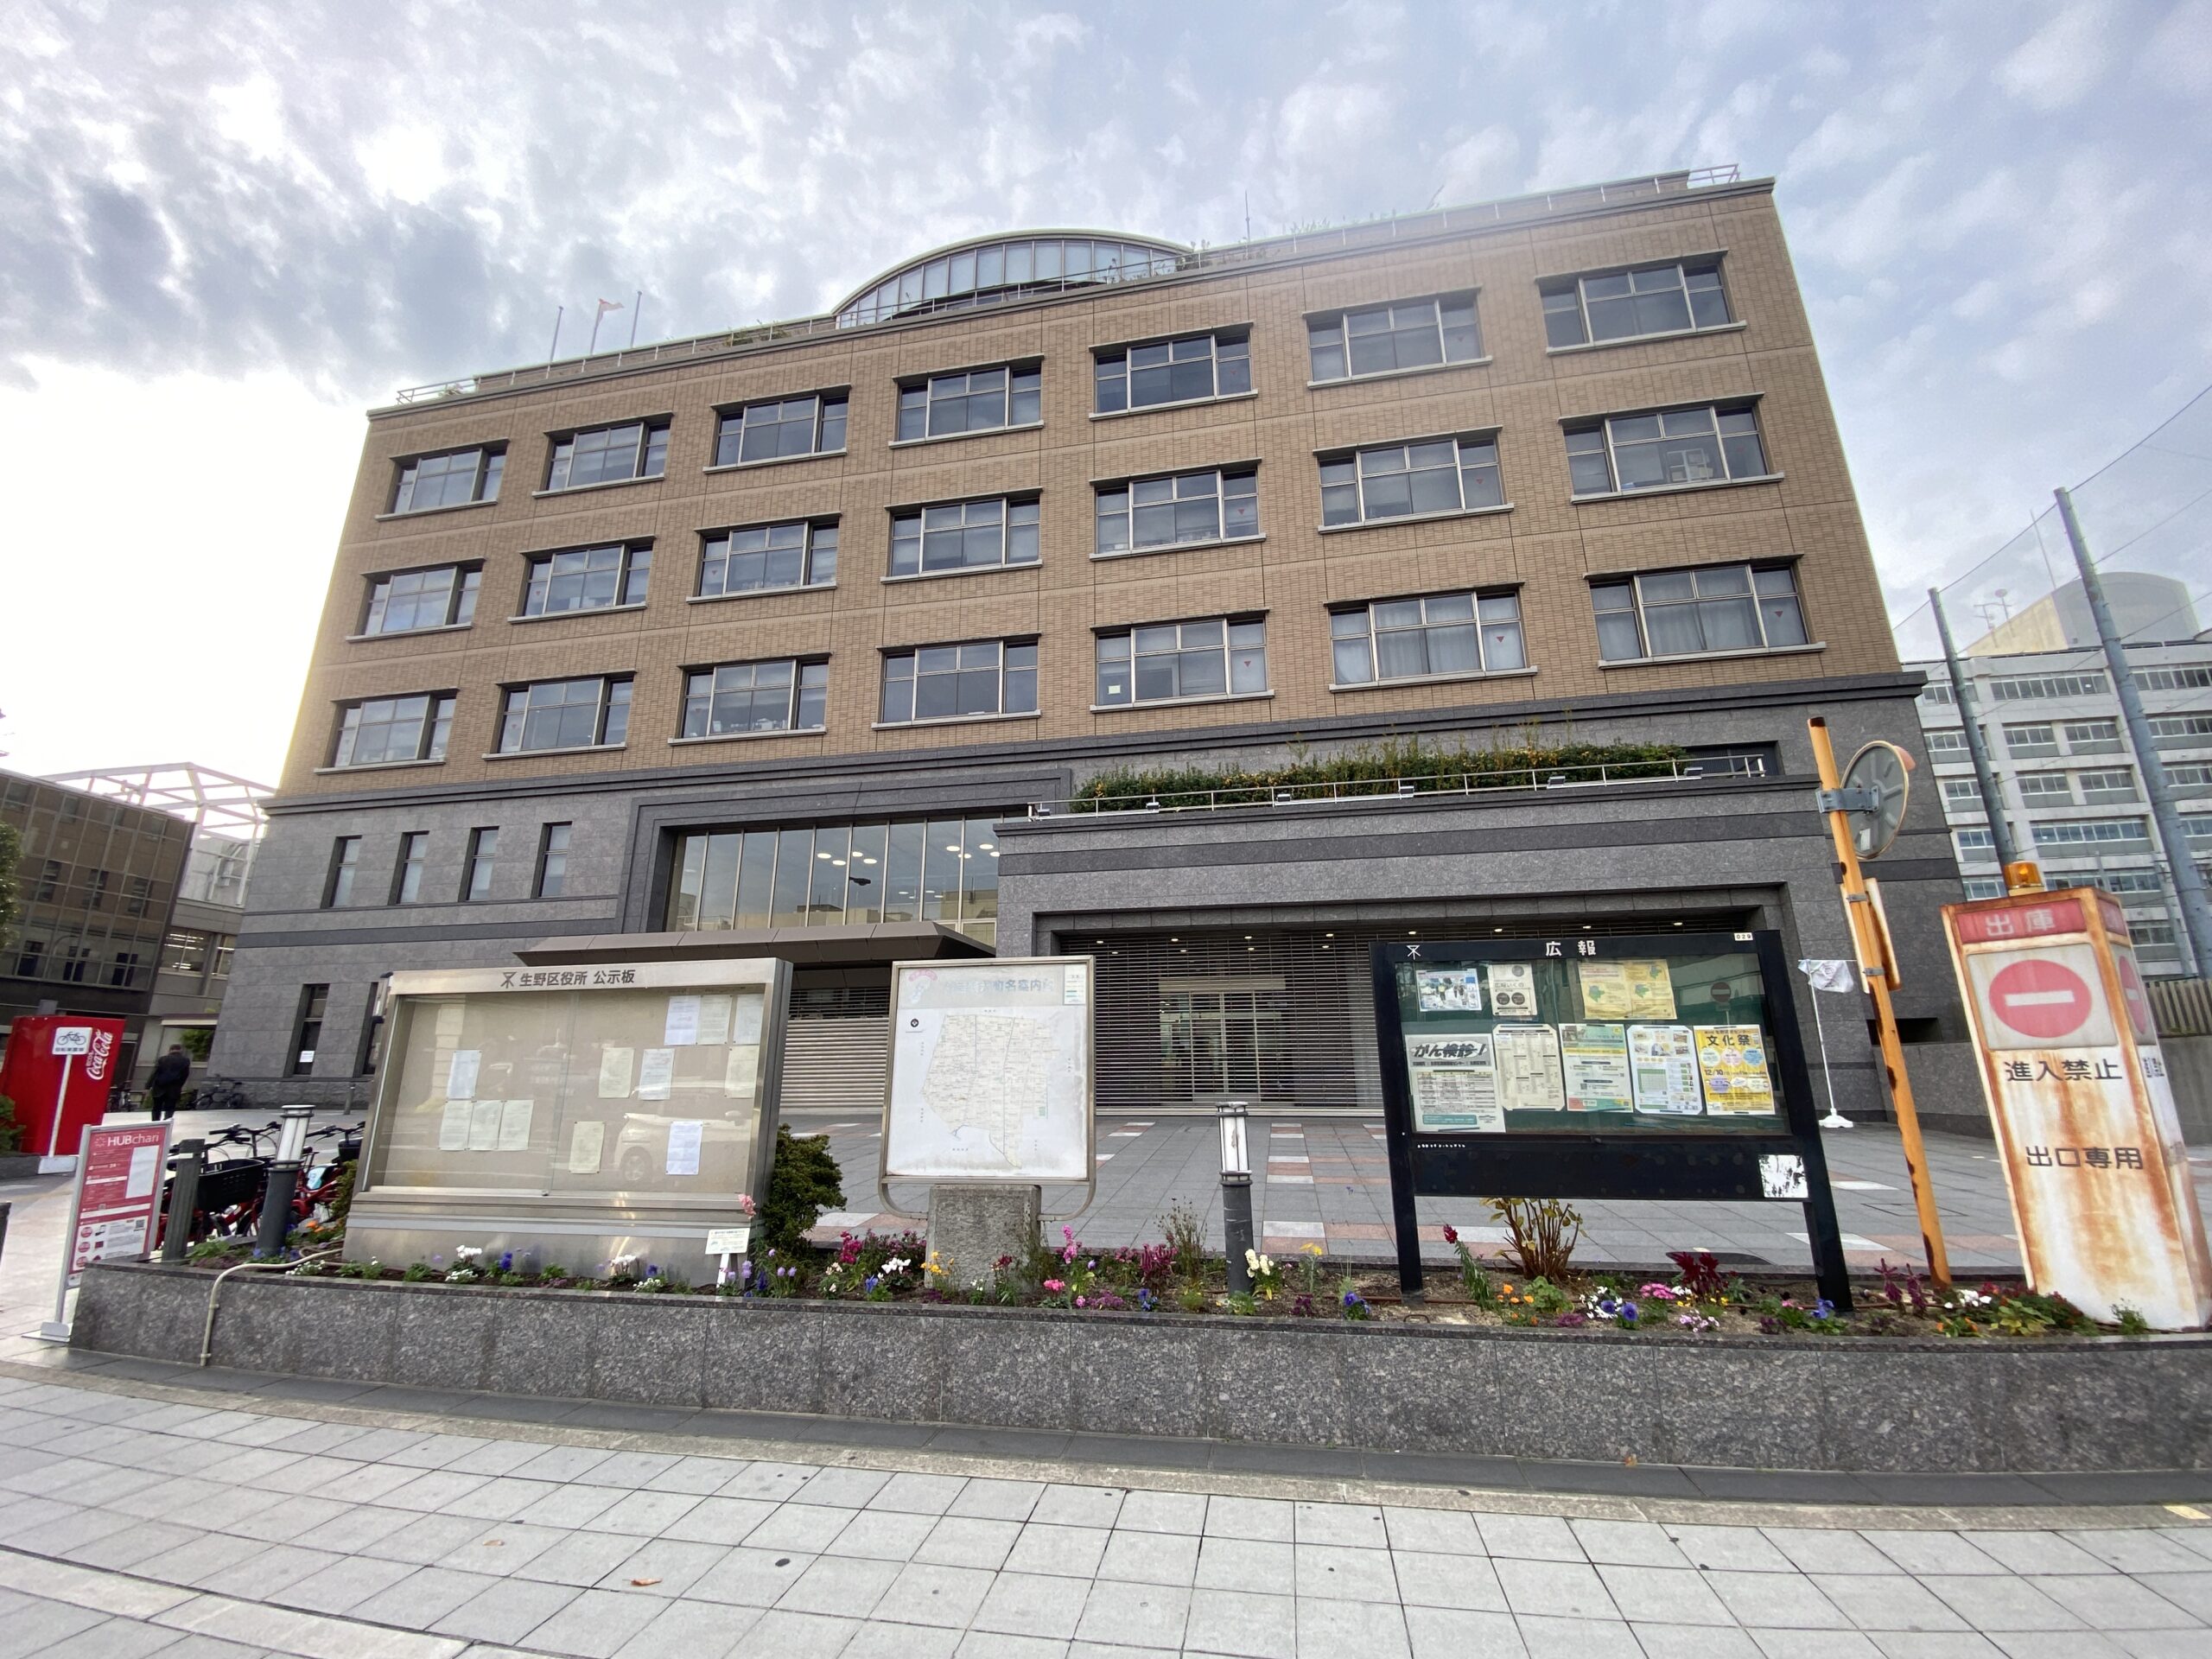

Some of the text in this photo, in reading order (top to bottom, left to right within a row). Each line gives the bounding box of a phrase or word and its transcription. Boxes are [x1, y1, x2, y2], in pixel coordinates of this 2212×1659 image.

[1985, 909, 2056, 937] 出庫
[1545, 940, 1597, 957] 広報
[519, 969, 636, 987] 生野区役所 公示板
[1707, 1034, 1751, 1046] 文化祭
[86, 1029, 113, 1080] Coca-Cola
[2004, 1058, 2123, 1082] 進入禁止
[107, 1133, 160, 1147] HUBchari
[2025, 1146, 2144, 1170] 出口専用
